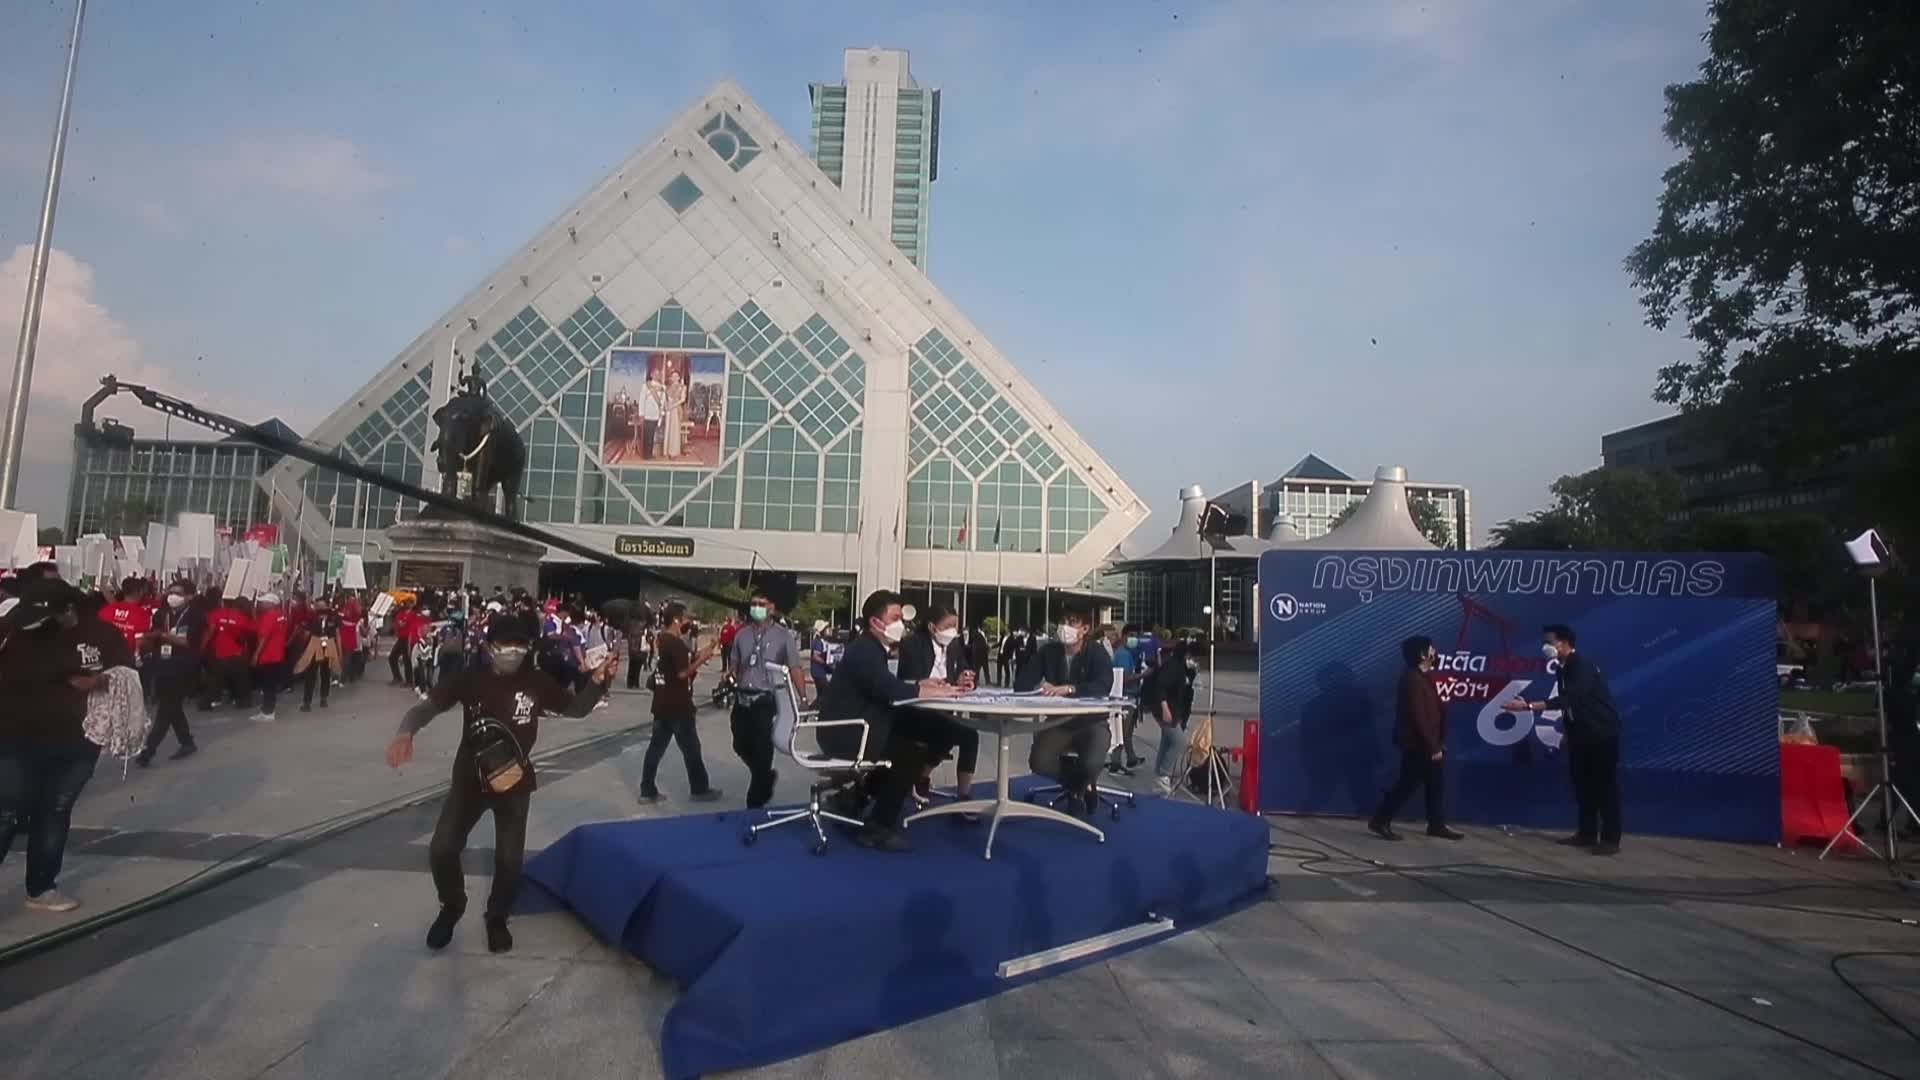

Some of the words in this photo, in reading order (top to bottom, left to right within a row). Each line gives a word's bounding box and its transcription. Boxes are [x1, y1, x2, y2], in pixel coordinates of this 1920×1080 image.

[1312, 555, 1726, 603] กรุงเทพมหานคร
